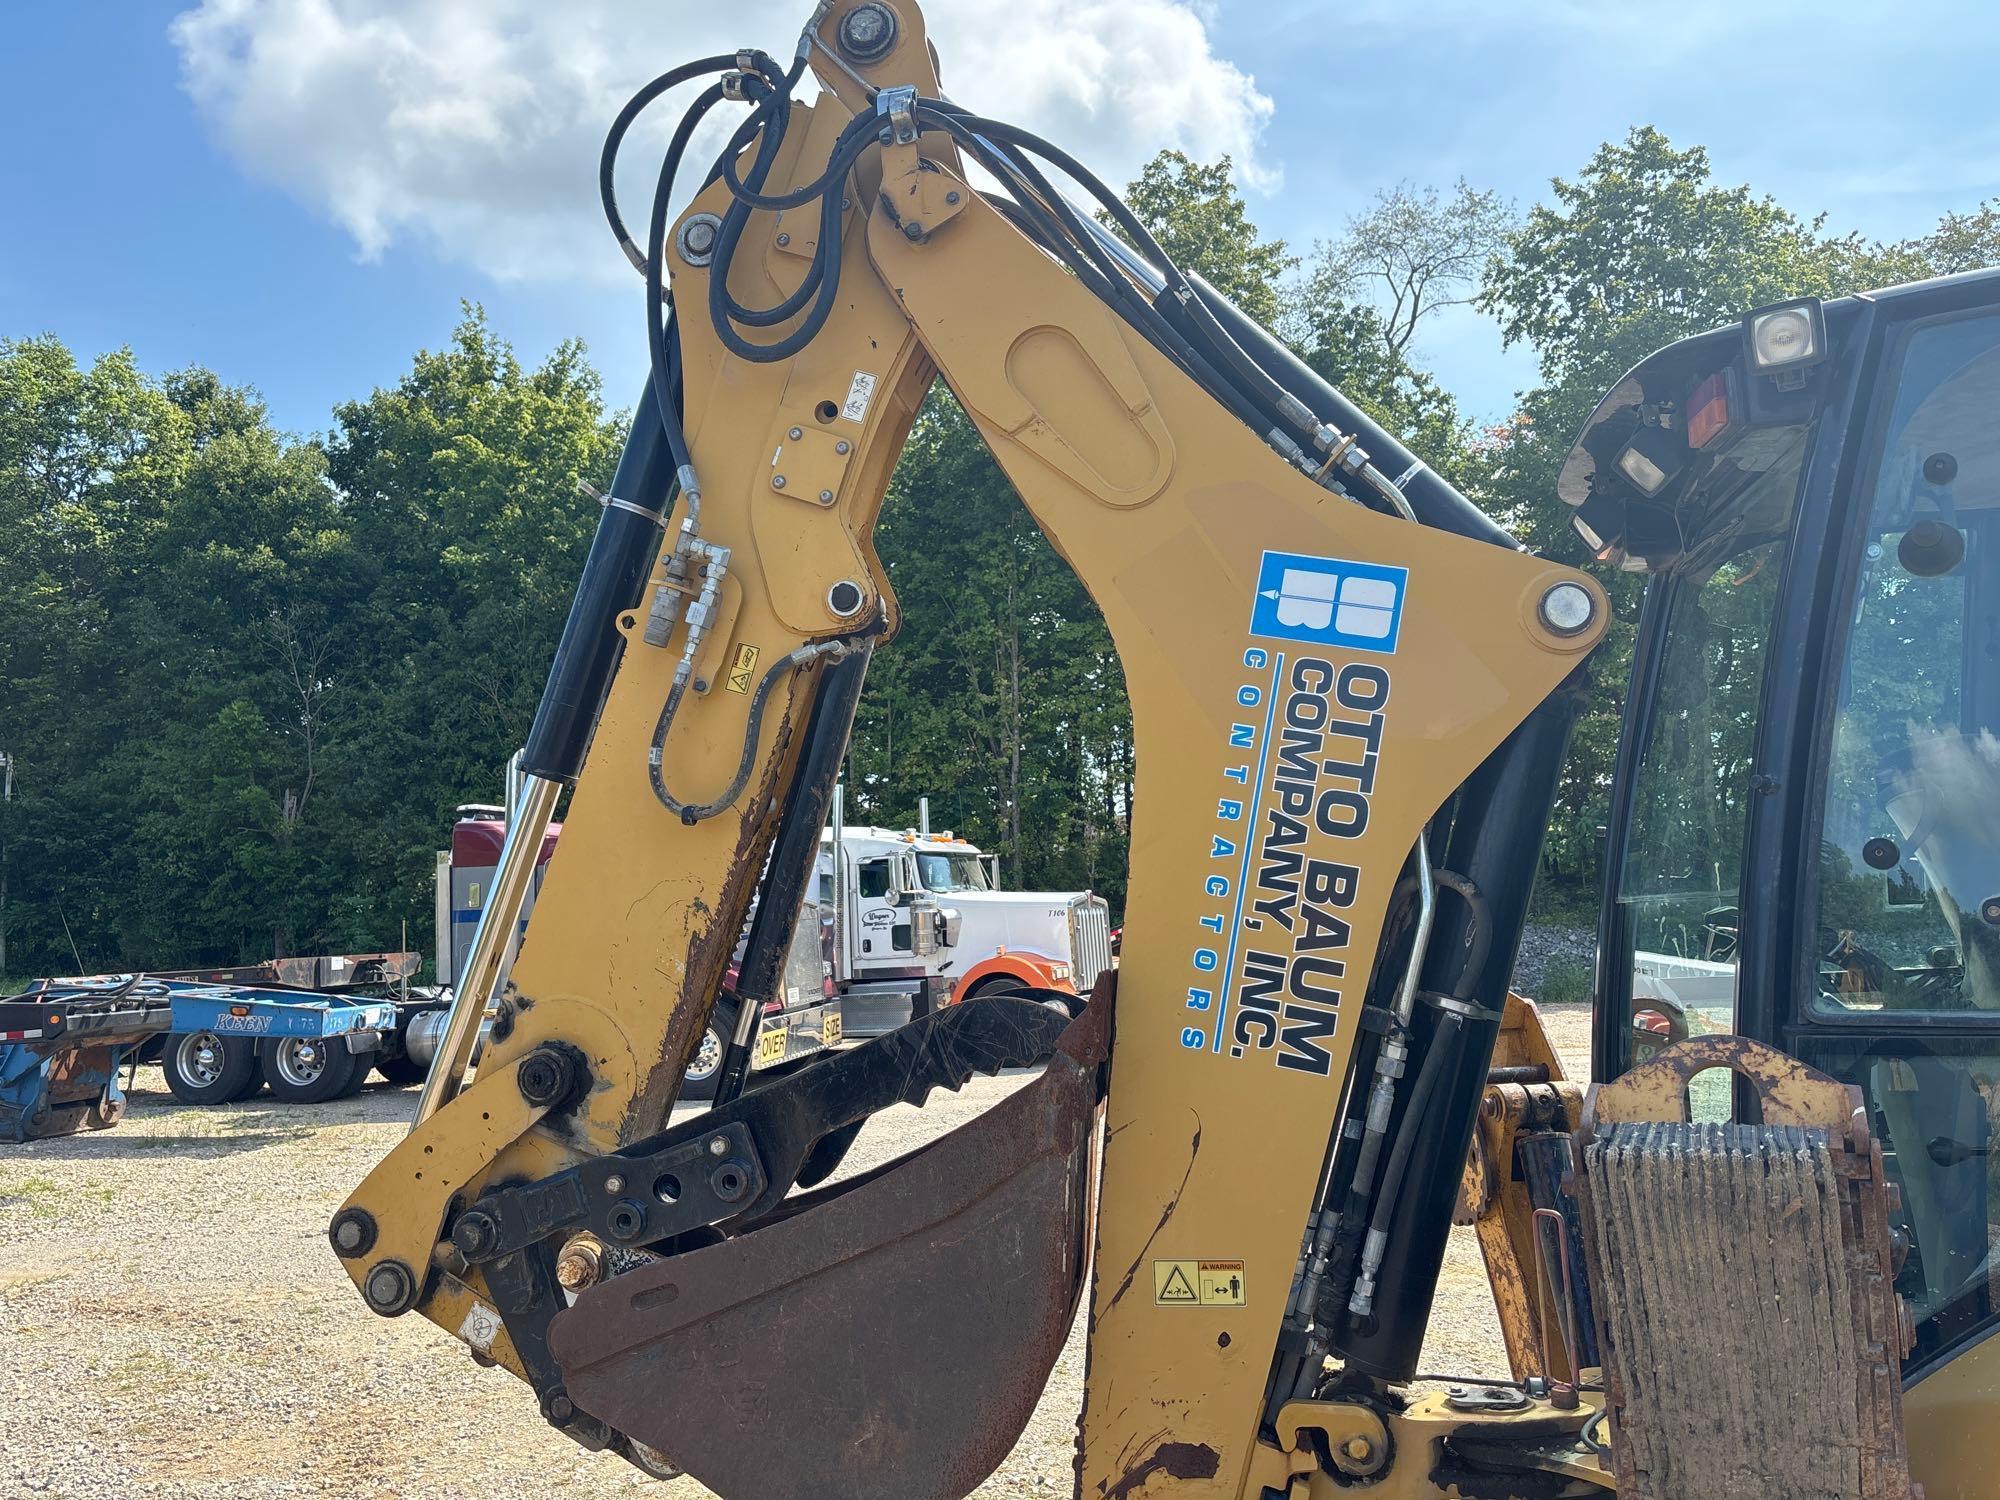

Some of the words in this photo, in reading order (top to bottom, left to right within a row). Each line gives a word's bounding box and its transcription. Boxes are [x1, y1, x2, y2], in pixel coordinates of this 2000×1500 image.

[1244, 657, 1334, 935] COMPANY,
[1315, 663, 1391, 839] OTTO
[1181, 647, 1268, 1049] CONTRACTORS
[214, 1013, 273, 1033] KEEN
[825, 1017, 840, 1039] SIZE
[1230, 949, 1288, 1059] INC.
[1275, 858, 1361, 1077] BAUM
[762, 1033, 786, 1057] OVER
